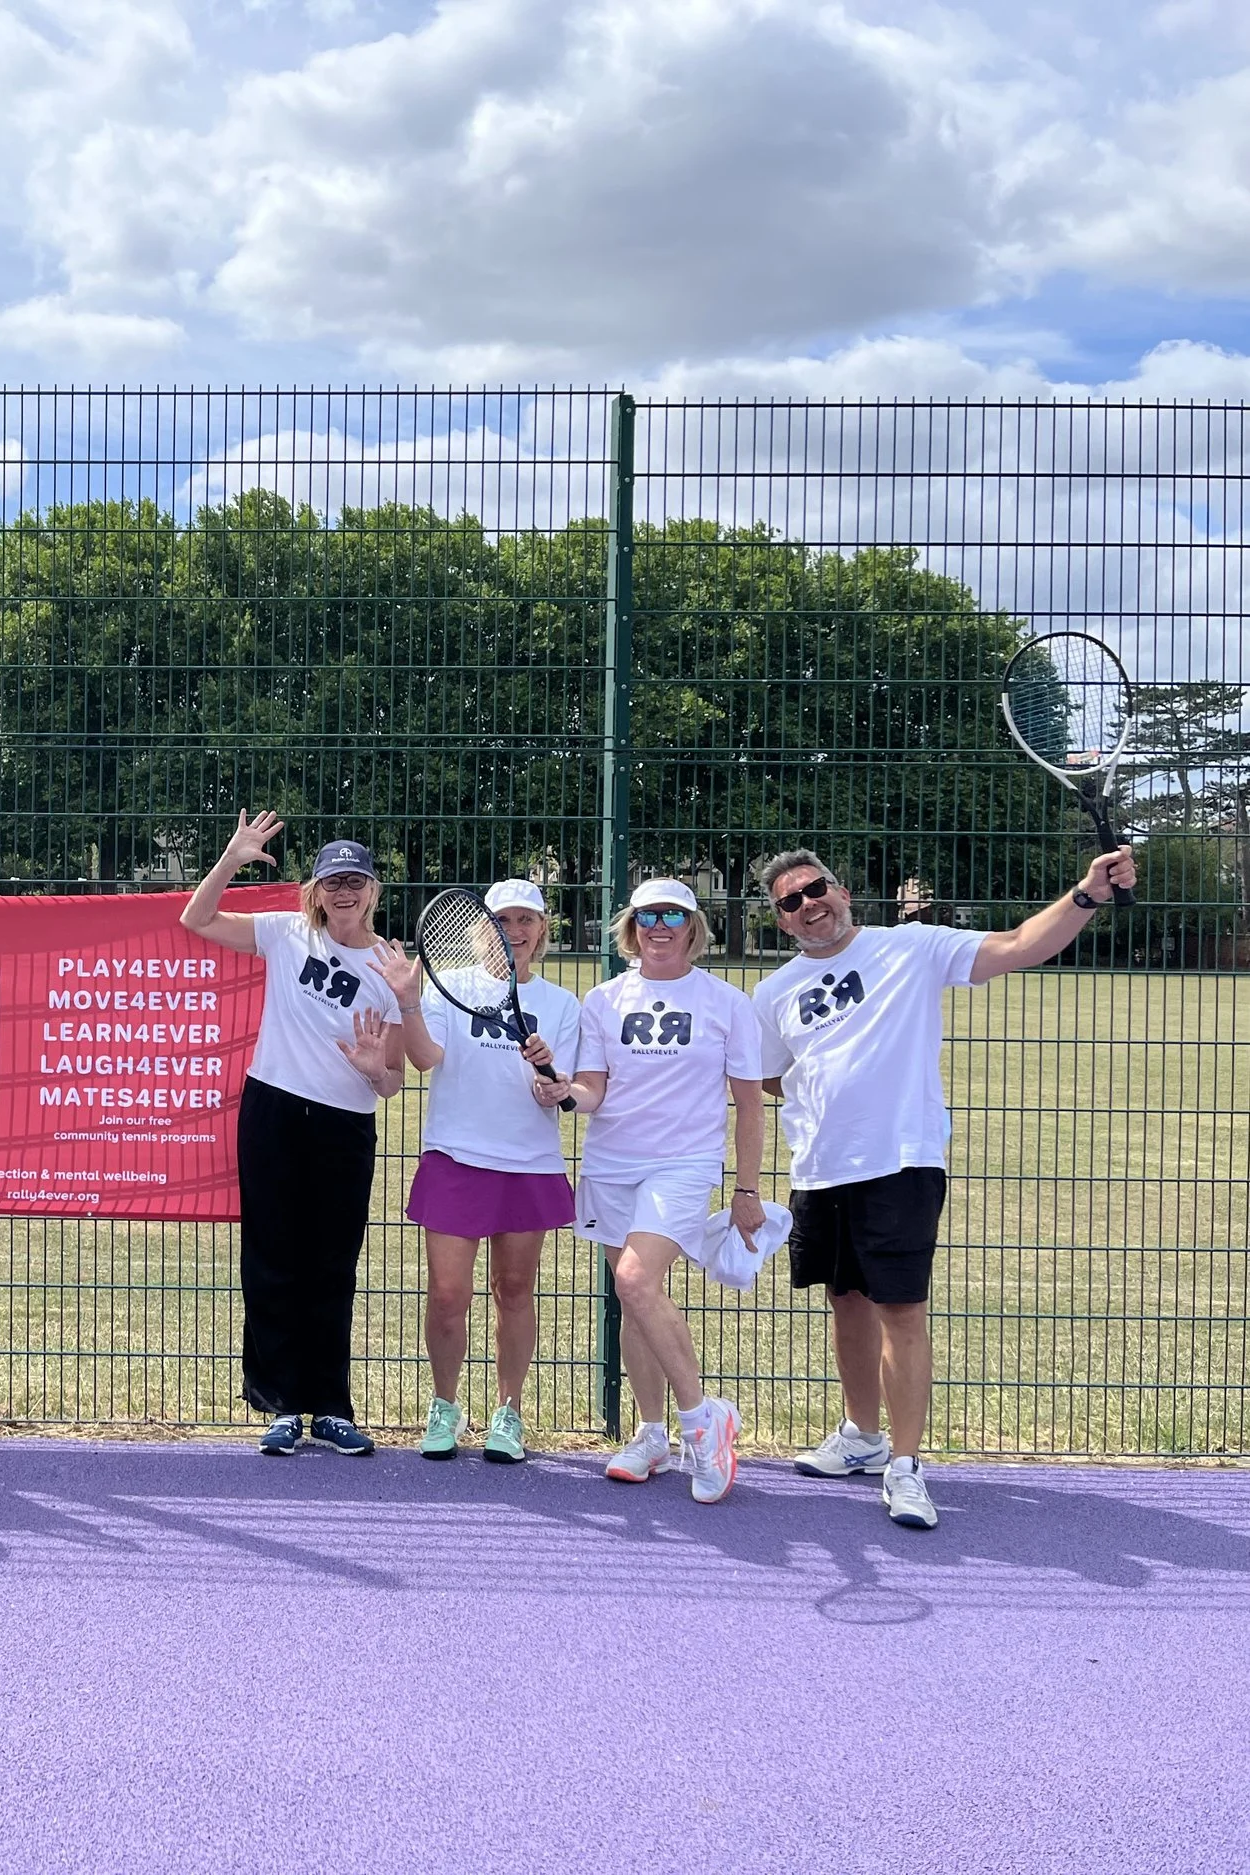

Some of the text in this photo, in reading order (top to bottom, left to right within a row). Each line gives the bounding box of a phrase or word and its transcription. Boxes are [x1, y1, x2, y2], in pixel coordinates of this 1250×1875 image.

[58, 958, 216, 978] PLAY4EVER
[48, 989, 217, 1011] MOVE4EVER
[43, 1022, 221, 1044] LEARN4EVER
[40, 1054, 223, 1076] LAUGH4EVER
[39, 1086, 222, 1109] MATES4EVER
[98, 1114, 172, 1126] Join our free
[53, 1131, 216, 1144] community tennis programs
[40, 1168, 50, 1180] &
[54, 1169, 100, 1181] mental
[103, 1170, 167, 1185] wellbeing
[7, 1188, 100, 1204] rally4ever.org
